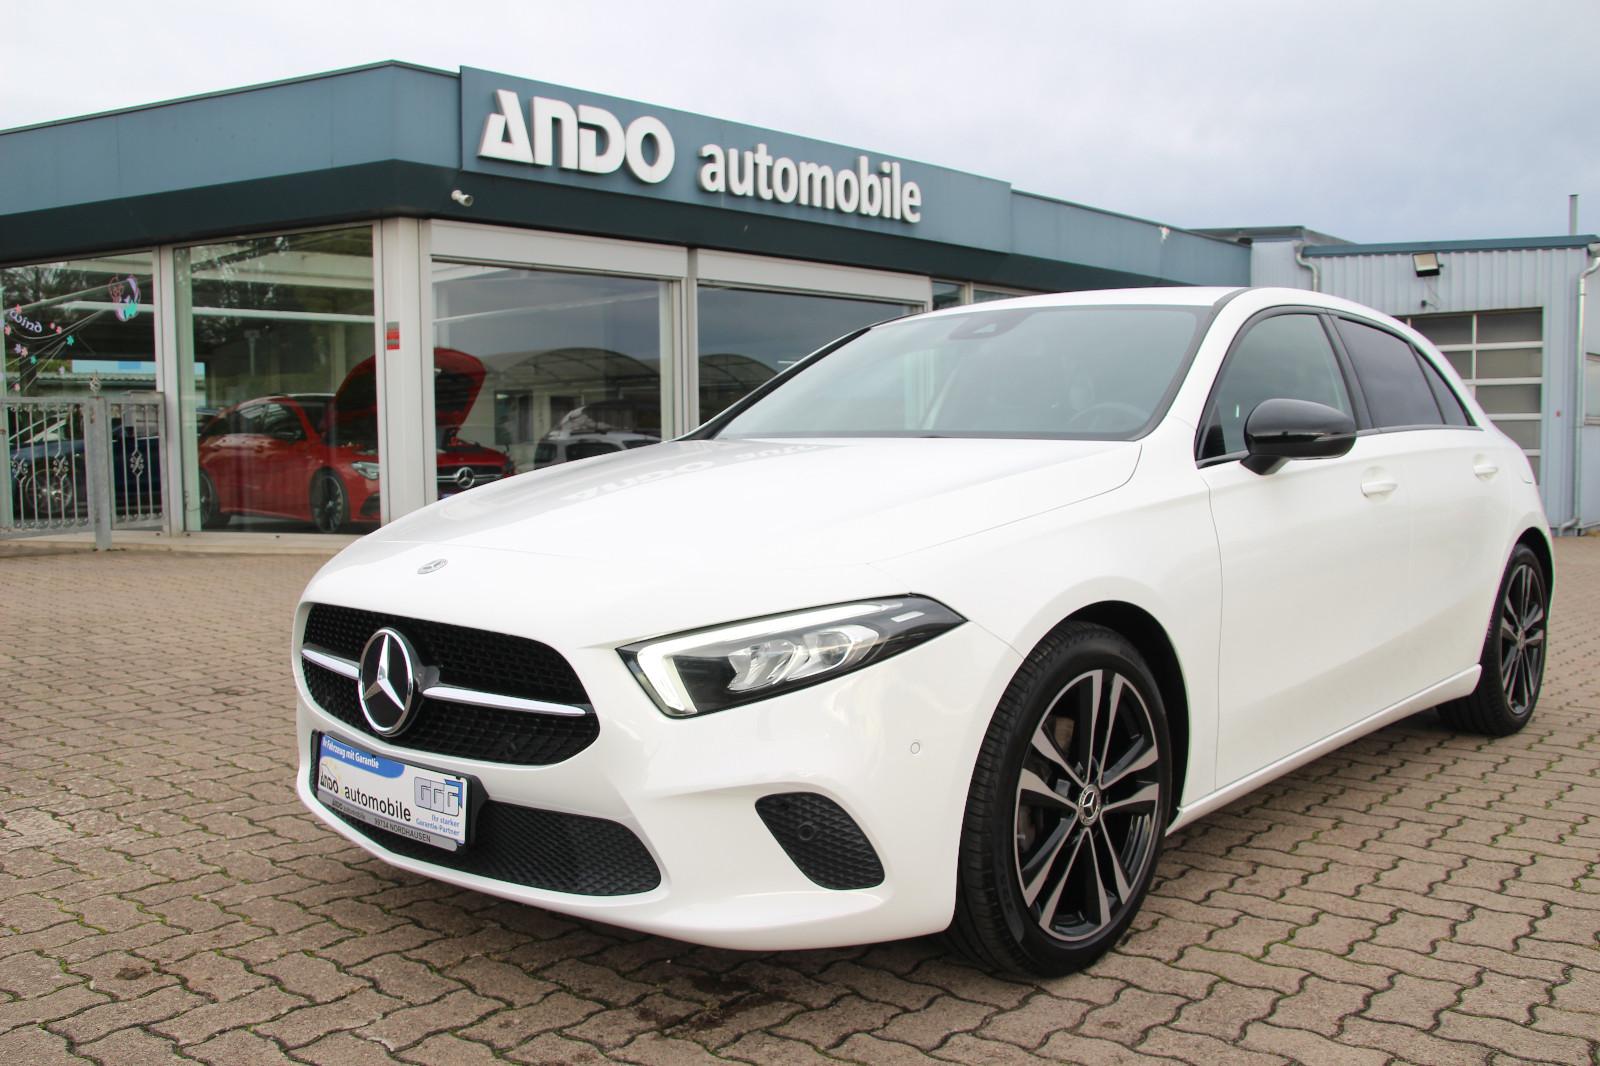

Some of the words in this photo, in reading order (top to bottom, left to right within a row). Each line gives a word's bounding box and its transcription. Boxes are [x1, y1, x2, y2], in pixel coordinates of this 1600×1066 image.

[477, 88, 675, 184] ANDO
[697, 142, 922, 223] automobile
[346, 749, 355, 760] mit
[355, 752, 379, 769] Garantie
[344, 785, 411, 822] automobile
